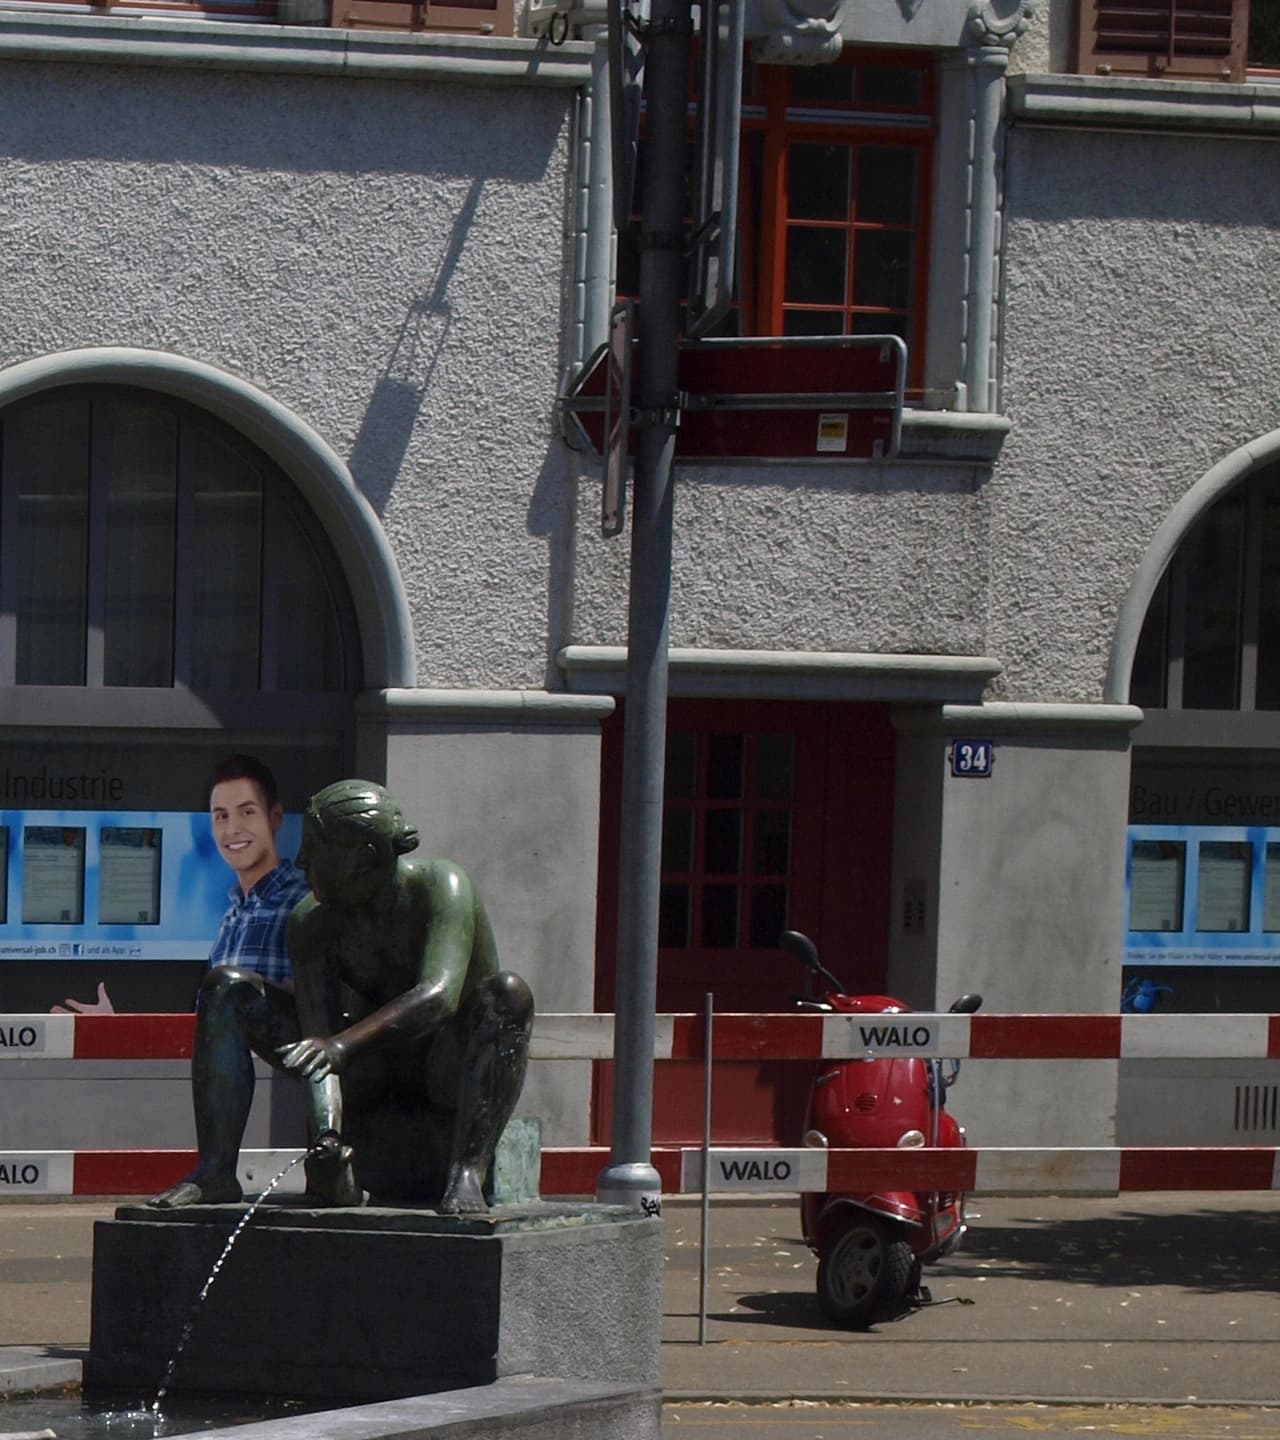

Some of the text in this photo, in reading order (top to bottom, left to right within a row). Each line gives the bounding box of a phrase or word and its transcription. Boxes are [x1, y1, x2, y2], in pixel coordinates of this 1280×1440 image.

[959, 744, 987, 771] 34
[4, 766, 124, 801] Industrie
[1133, 785, 1177, 816] Bau
[859, 1026, 930, 1047] WALO
[719, 1161, 791, 1181] WALO
